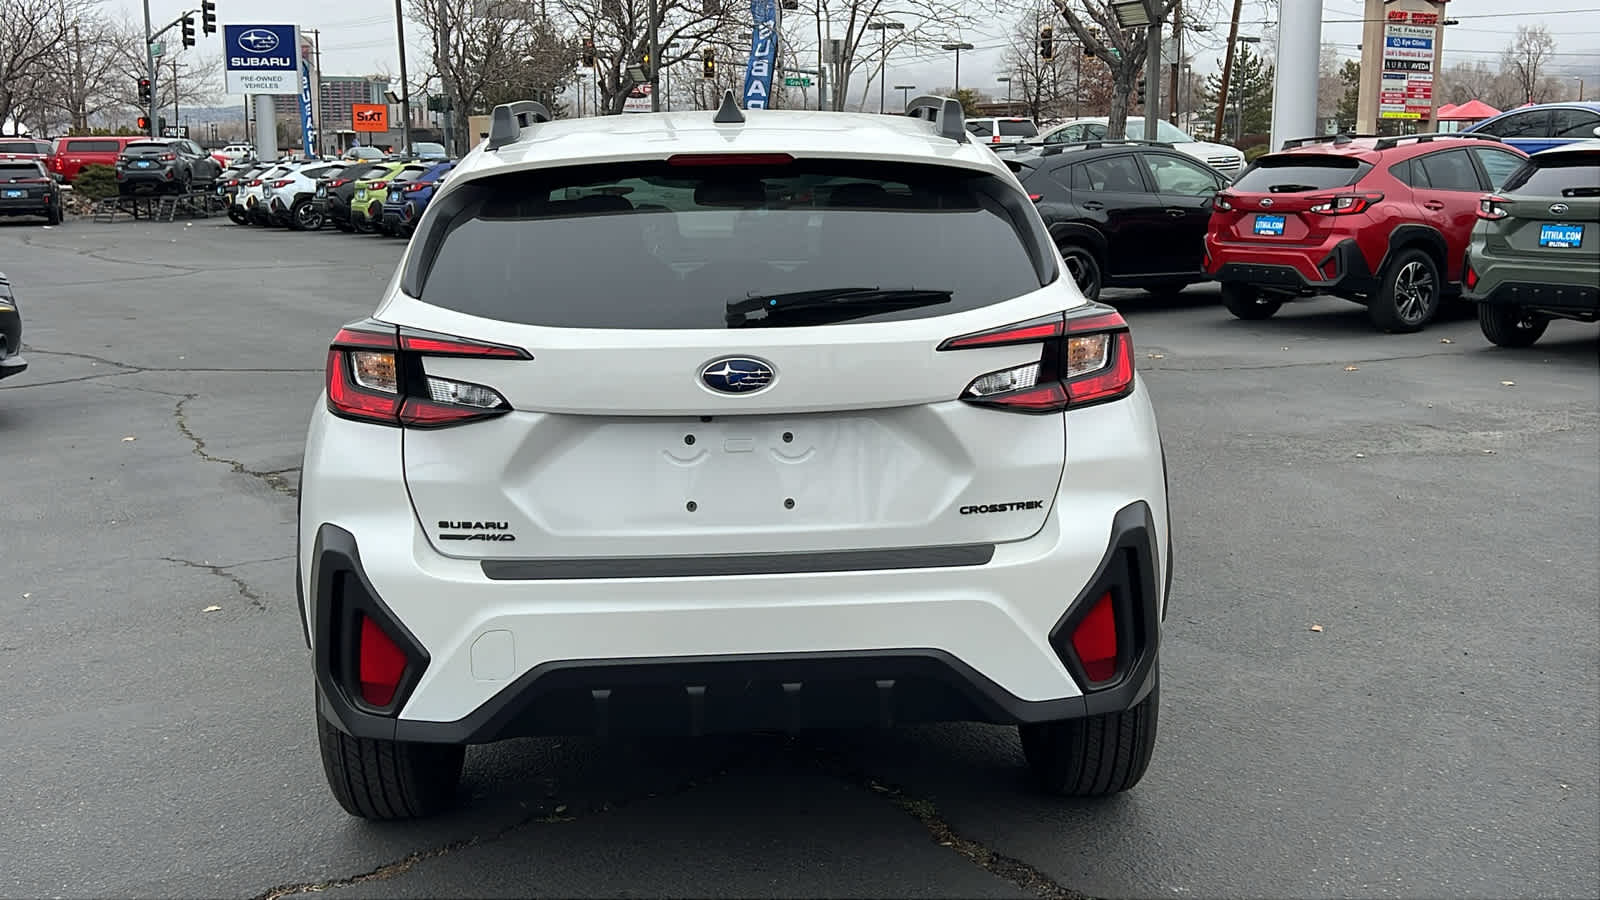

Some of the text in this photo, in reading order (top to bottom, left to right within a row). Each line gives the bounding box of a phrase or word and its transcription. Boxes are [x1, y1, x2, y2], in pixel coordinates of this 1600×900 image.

[231, 57, 290, 66] SUBARU
[1386, 61, 1407, 69] AURA
[1541, 230, 1582, 240] LITHIA.COM
[960, 500, 1043, 514] CROSSTREK
[438, 520, 508, 530] SUBARU
